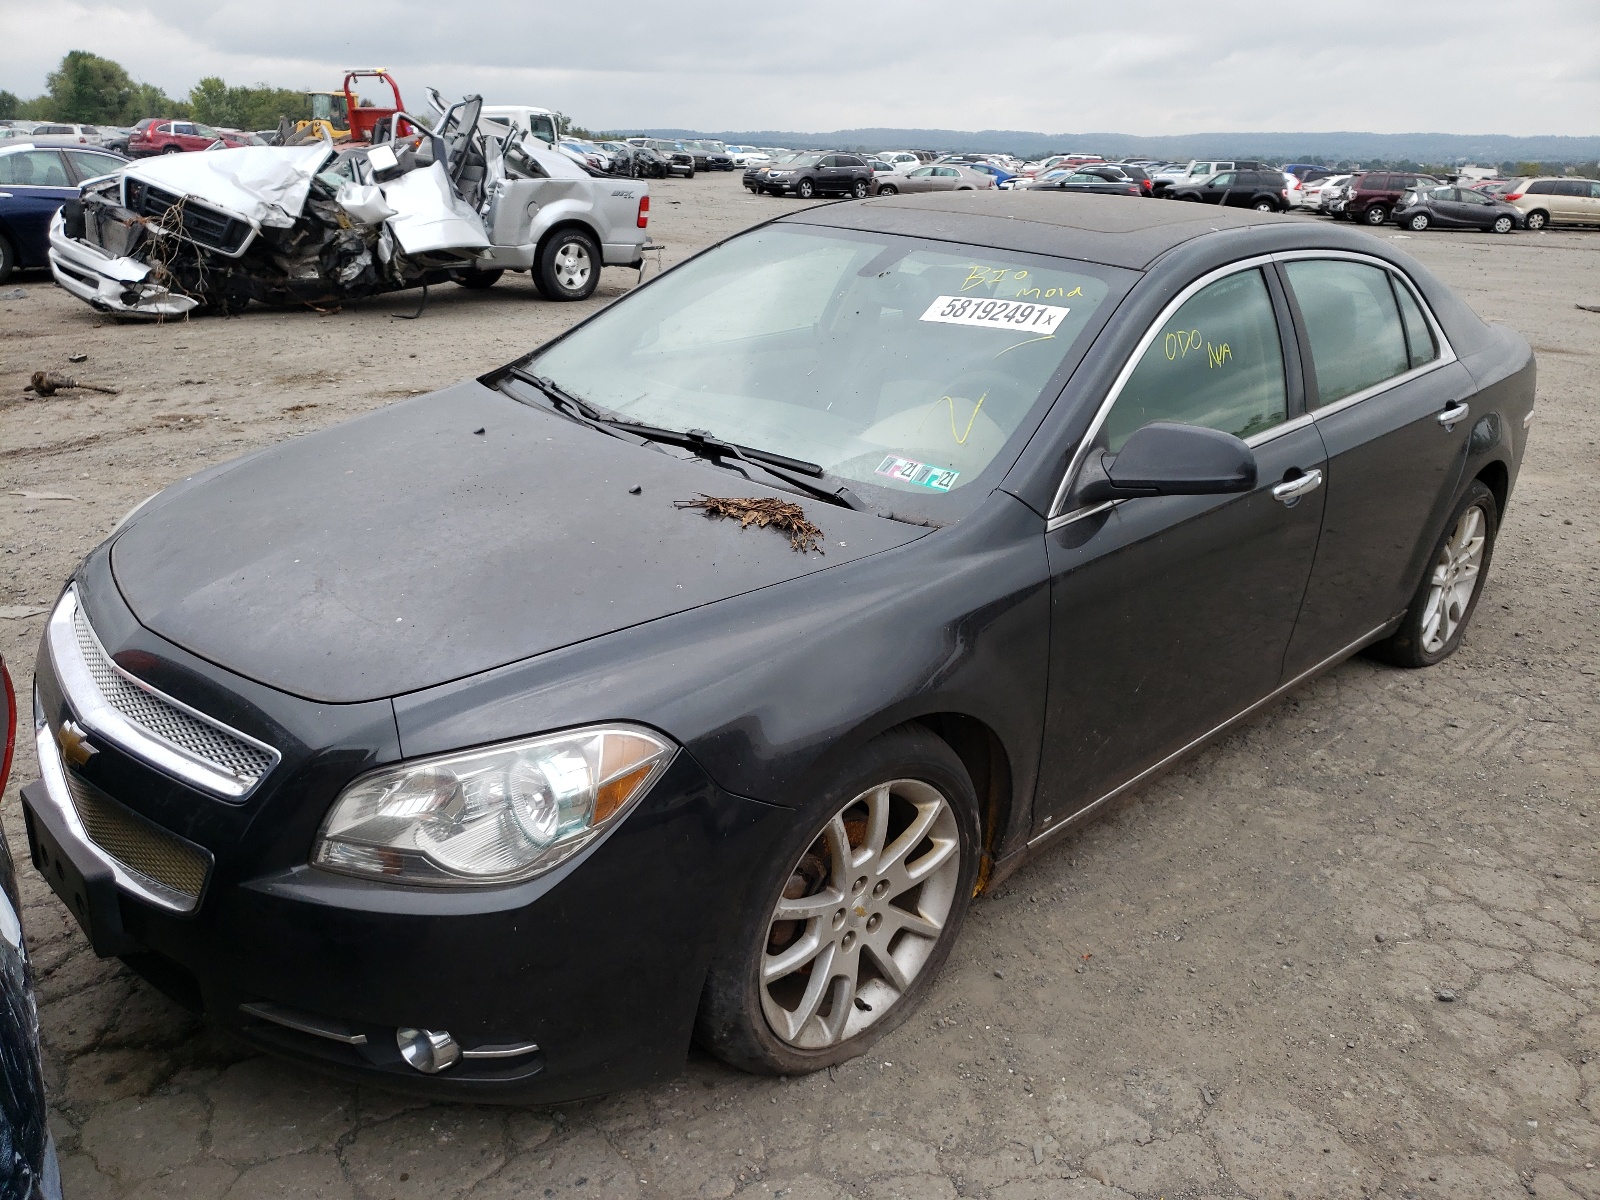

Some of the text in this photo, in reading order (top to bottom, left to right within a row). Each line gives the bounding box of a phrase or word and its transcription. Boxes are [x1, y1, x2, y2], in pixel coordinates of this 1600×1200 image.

[958, 265, 1028, 292] BIO
[1165, 329, 1202, 360] ODO
[900, 462, 918, 478] 21
[938, 472, 955, 488] 21
